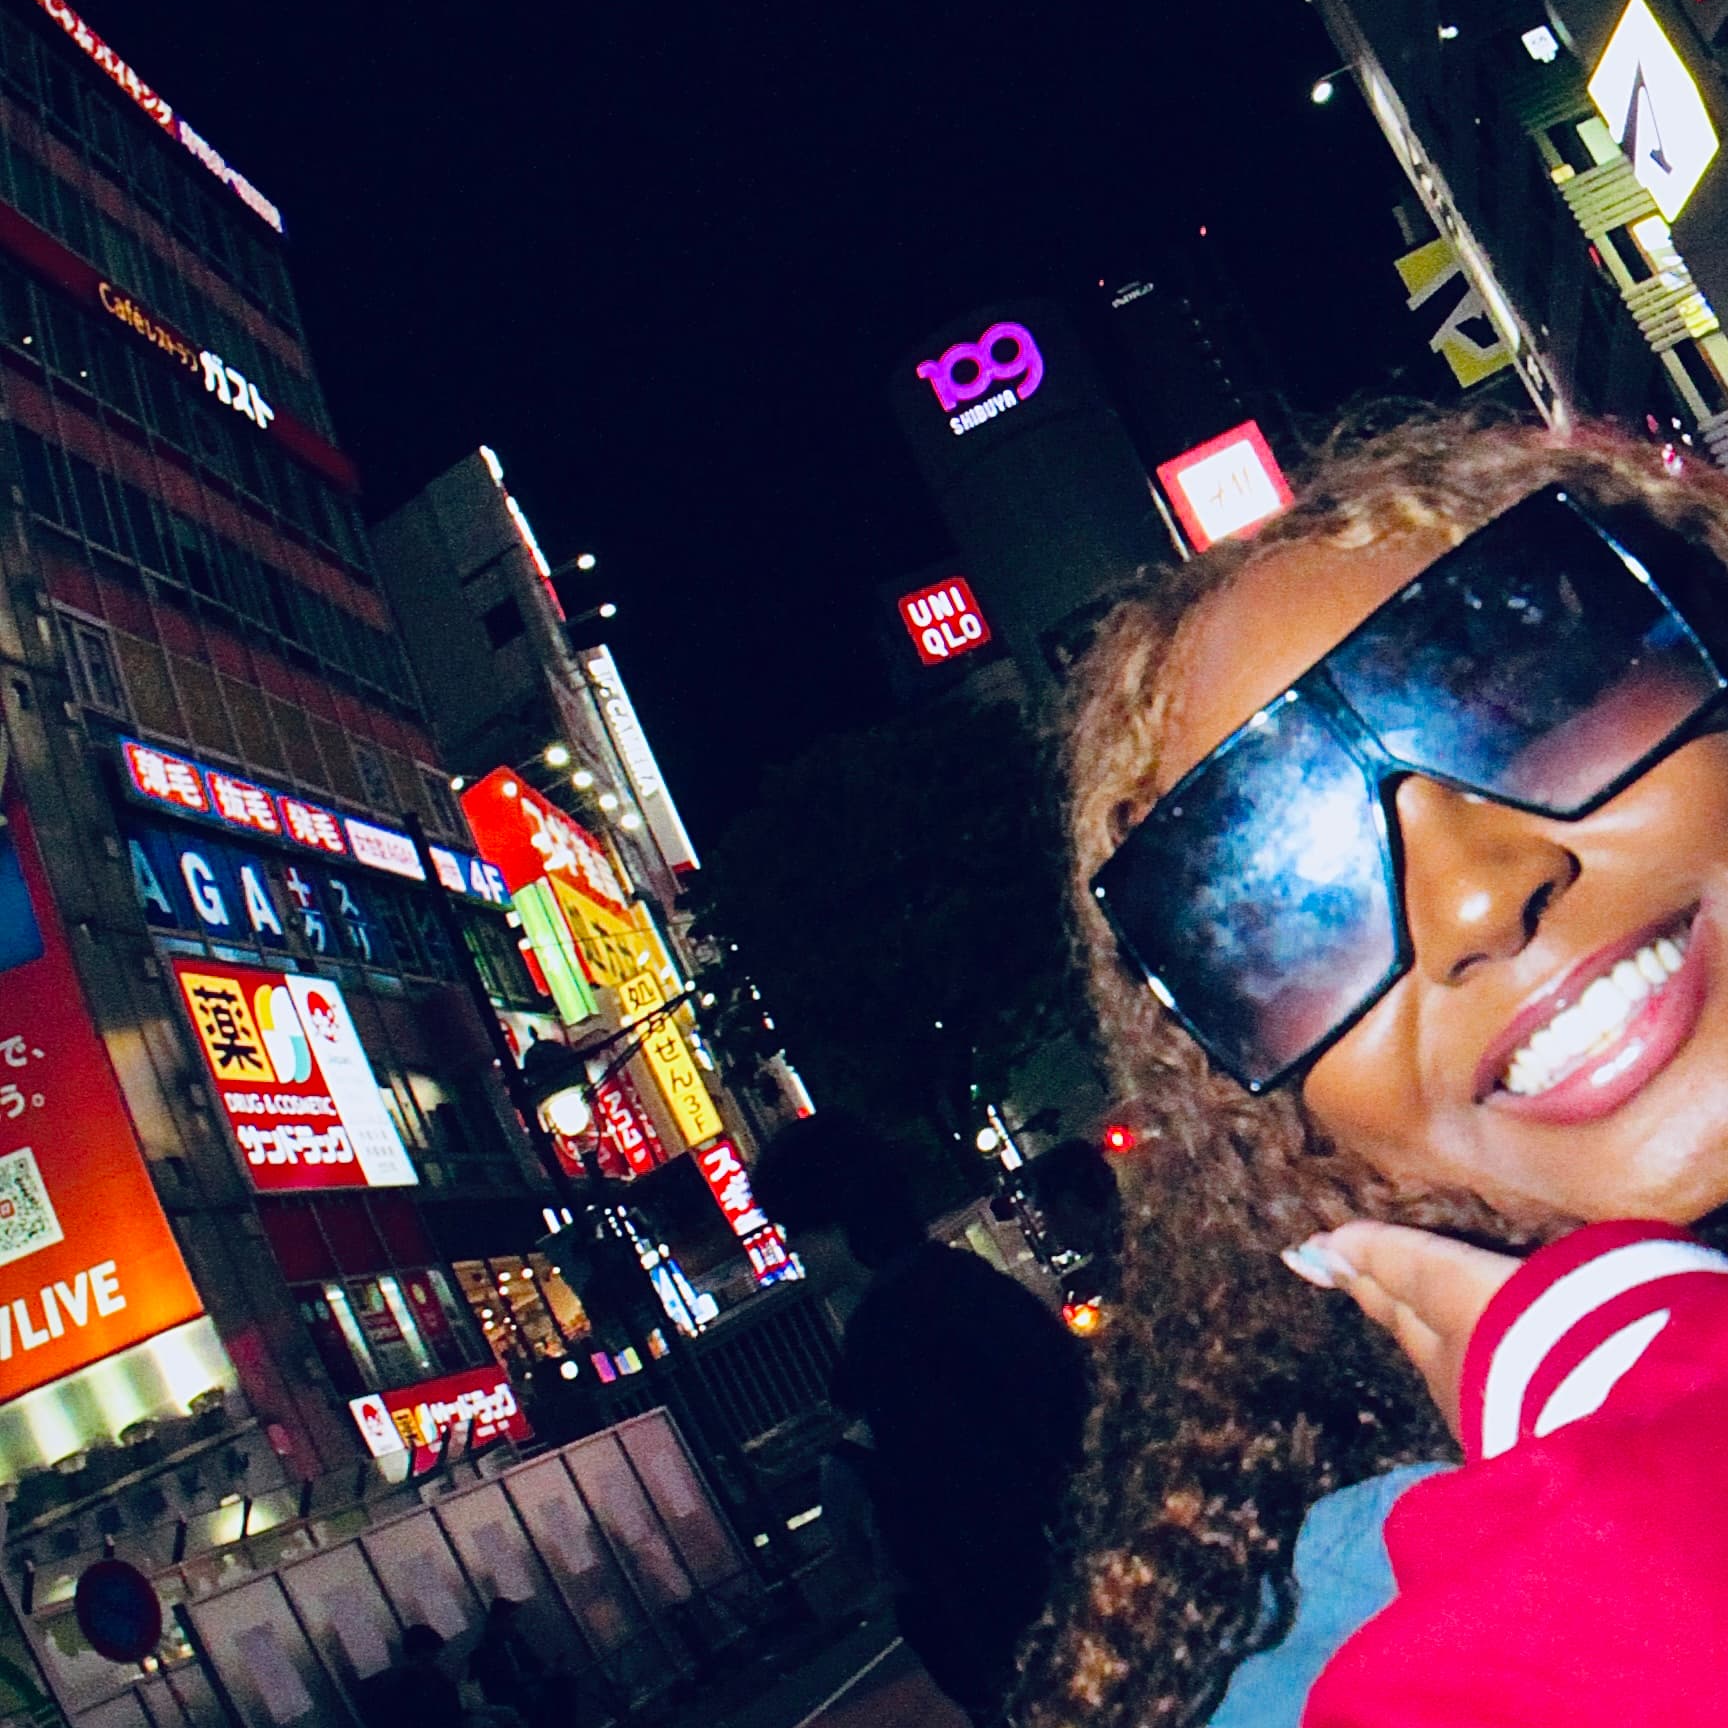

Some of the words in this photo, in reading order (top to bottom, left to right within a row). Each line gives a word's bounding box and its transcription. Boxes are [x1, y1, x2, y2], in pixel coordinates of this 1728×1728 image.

[199, 351, 275, 428] ガスト
[915, 320, 1044, 413] 109
[949, 389, 1018, 436] SHIBUYA
[906, 586, 967, 629] UNI
[920, 613, 982, 658] QLO
[129, 839, 284, 937] AGA
[469, 864, 502, 904] 4F
[193, 985, 264, 1071] 薬
[236, 1124, 355, 1166] サンドラッグ
